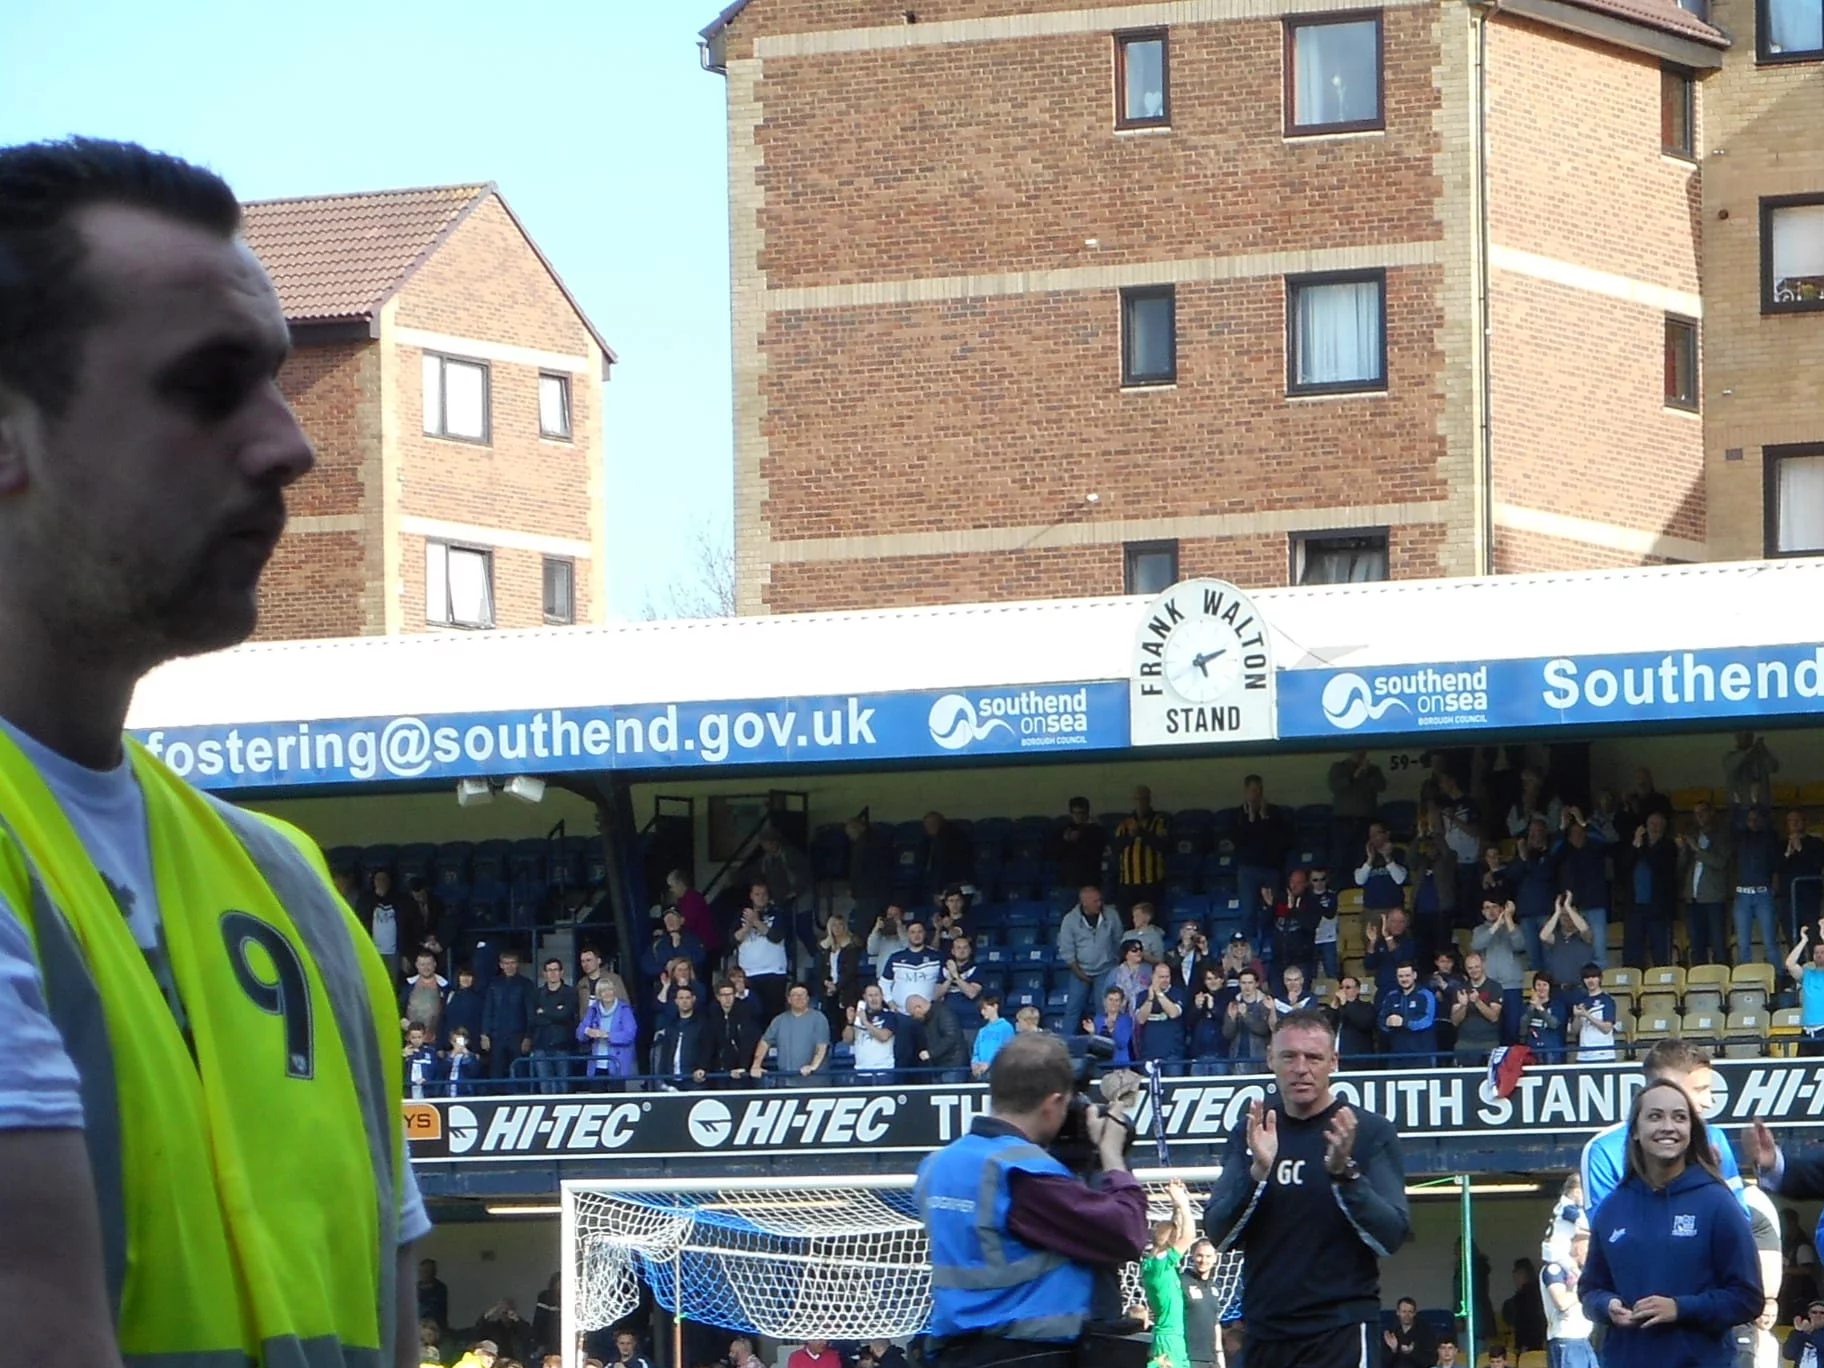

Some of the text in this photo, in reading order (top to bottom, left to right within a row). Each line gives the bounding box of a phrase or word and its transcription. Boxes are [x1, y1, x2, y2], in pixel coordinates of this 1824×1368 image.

[1140, 588, 1267, 696] FRANK WALTON
[1374, 665, 1488, 696] southend
[979, 688, 1088, 717] southend
[1417, 691, 1488, 713] onsea
[1020, 713, 1088, 735] onsea
[1166, 706, 1241, 734] STAND
[1417, 715, 1488, 726] BOROUGH COUNCIL
[145, 697, 877, 779] fostering@southend.gov.uk
[1021, 735, 1088, 747] BOROUGH COUNCIL
[219, 910, 314, 1080] 9
[481, 1103, 641, 1151] HI-TEC
[733, 1096, 896, 1145] HI-TEC
[1277, 1159, 1306, 1184] GC
